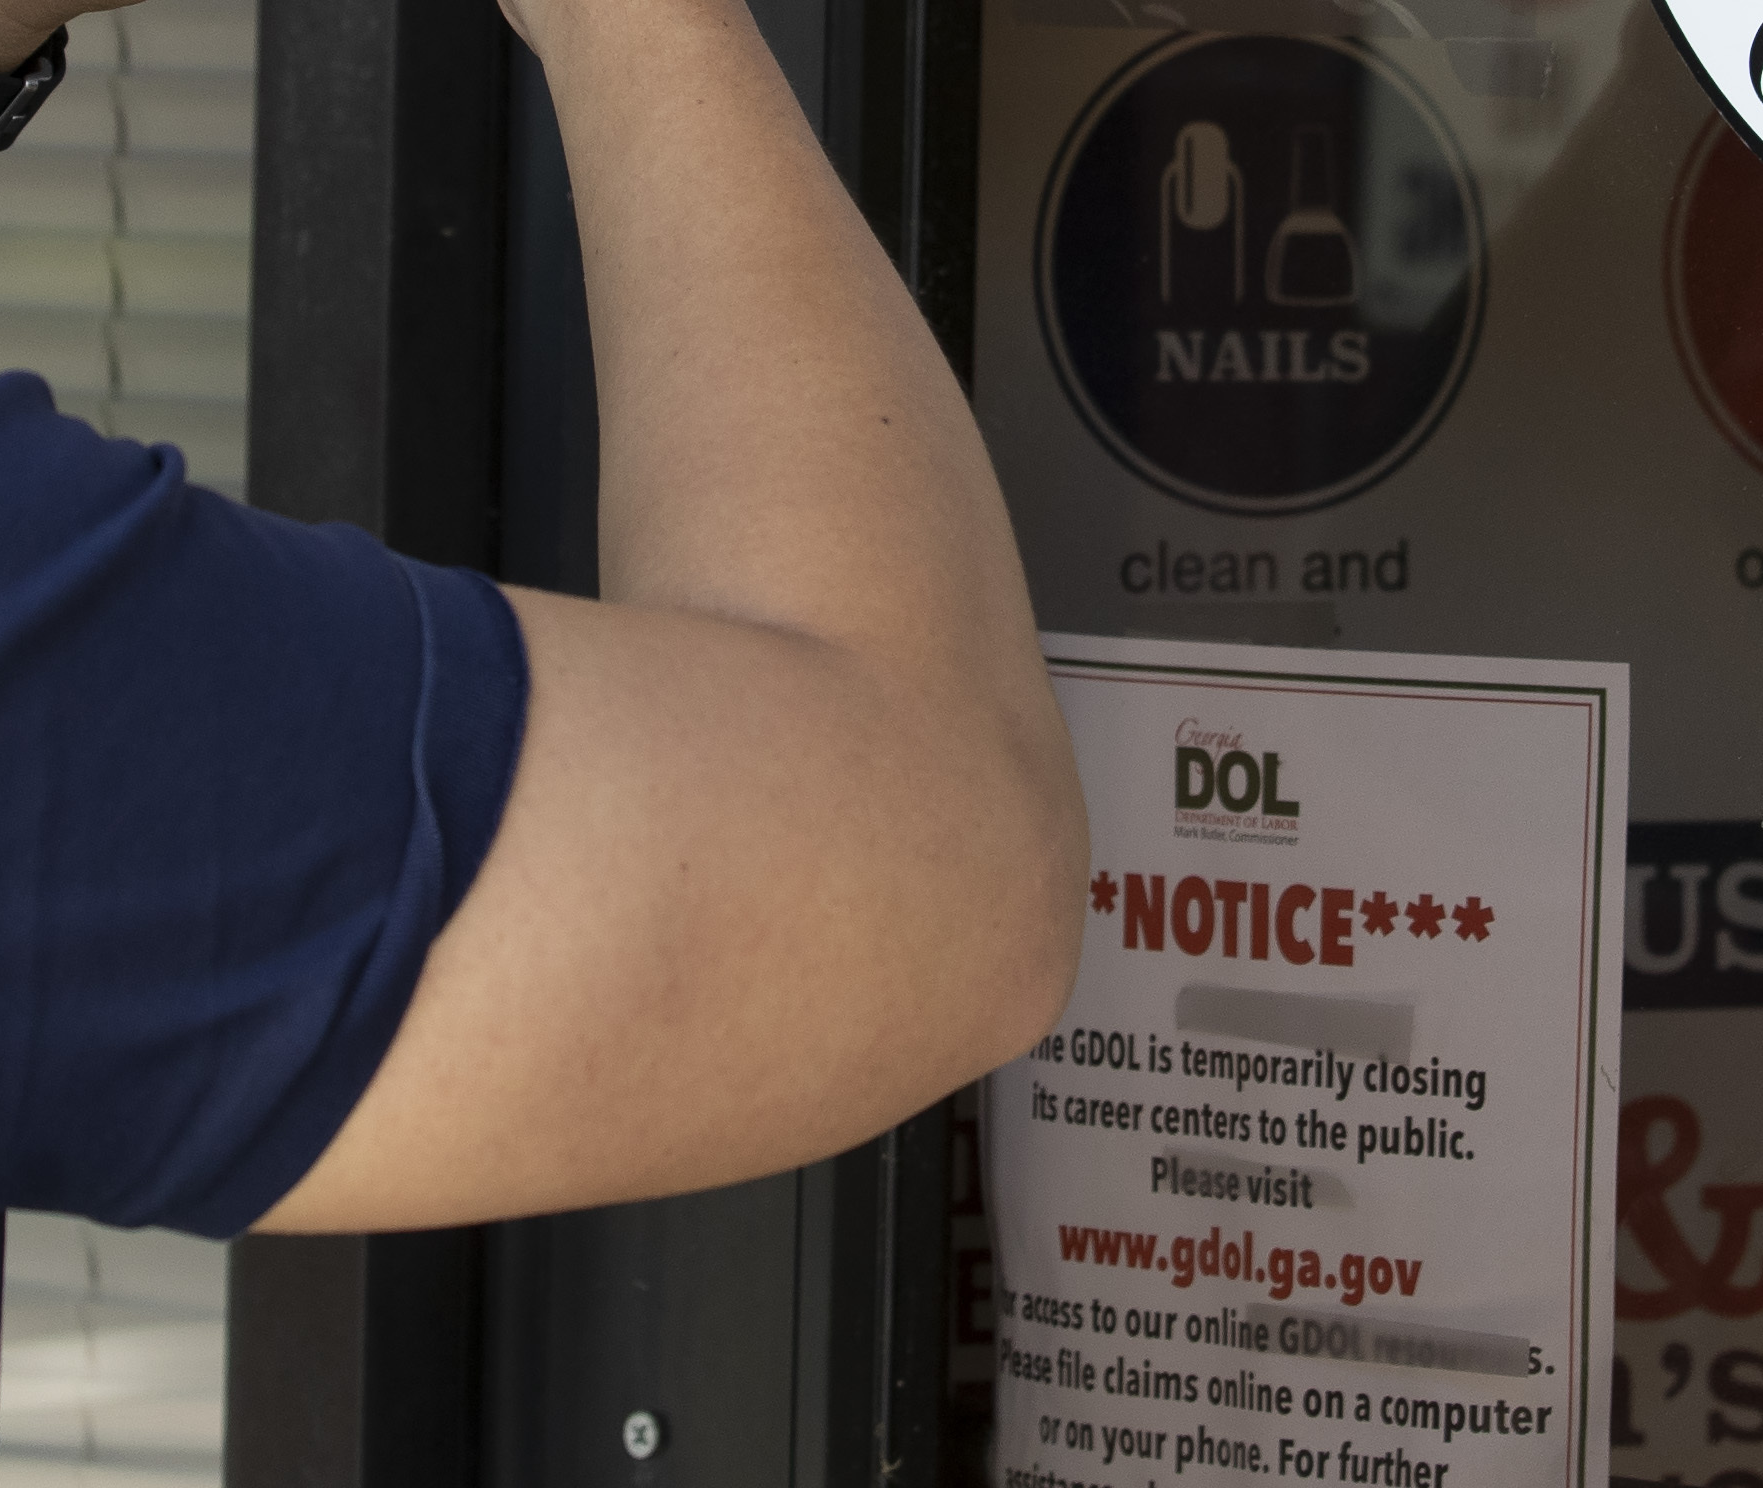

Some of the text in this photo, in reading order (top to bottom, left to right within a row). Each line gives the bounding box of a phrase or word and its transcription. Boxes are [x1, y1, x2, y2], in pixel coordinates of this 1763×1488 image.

[1154, 329, 1373, 386] NAILS
[1121, 540, 1410, 596] clean and
[1174, 746, 1300, 817] DOL
[1070, 1027, 1141, 1072] GDOL
[1148, 1032, 1173, 1074] is
[1180, 1039, 1355, 1103] temporarily
[1363, 1058, 1487, 1111] closing
[1031, 1083, 1475, 1164] its career centers to the public.
[1150, 1155, 1314, 1210] Please visit
[1058, 1224, 1424, 1307] www.gdol.ga.gov
[1090, 1297, 1117, 1335] to
[1124, 1308, 1178, 1340] our
[1185, 1306, 1270, 1353] online
[1057, 1347, 1096, 1391] file
[1103, 1355, 1199, 1404] claims
[1206, 1369, 1294, 1414] online
[1302, 1386, 1345, 1420] on
[1354, 1392, 1371, 1423] a
[1379, 1393, 1553, 1444] computer
[1038, 1413, 1450, 1488] or on your phone. For further
